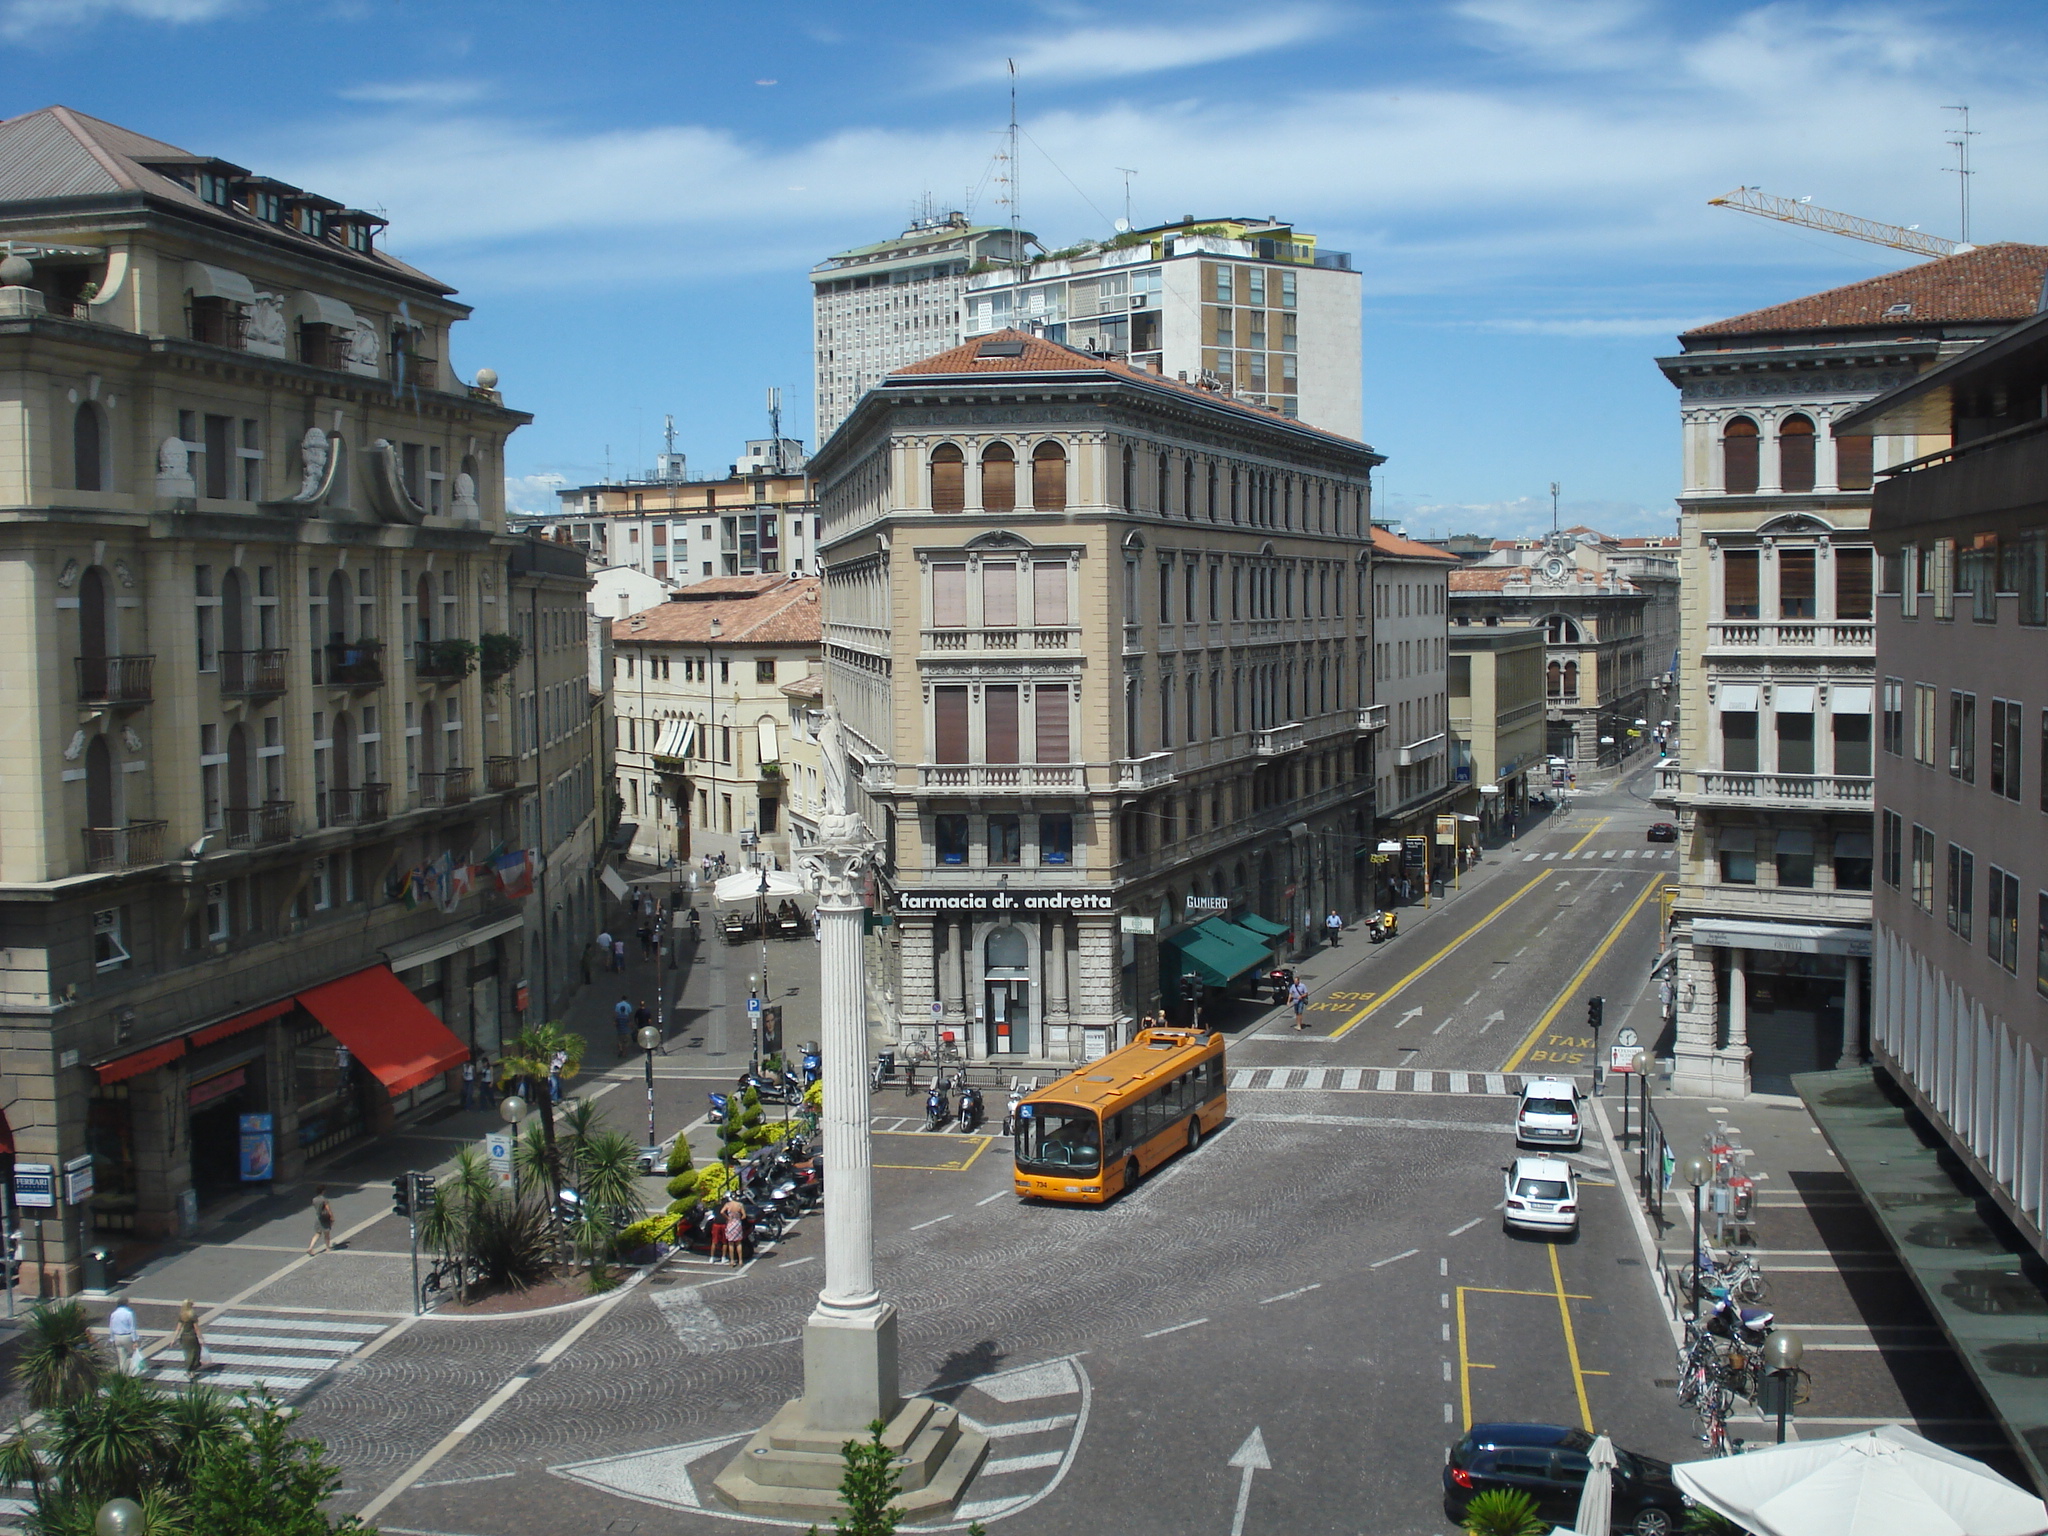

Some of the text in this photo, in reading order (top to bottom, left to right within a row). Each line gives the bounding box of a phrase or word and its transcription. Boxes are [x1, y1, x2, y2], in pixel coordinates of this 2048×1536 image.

[900, 893, 1111, 909] farmacia dr. andretta
[1186, 895, 1229, 910] GUMIERO
[1328, 991, 1377, 1001] BUS
[1306, 1002, 1357, 1012] TAXI
[1548, 1034, 1596, 1048] TAXI
[1530, 1050, 1585, 1064] BUS
[16, 1178, 48, 1186] FERRARI
